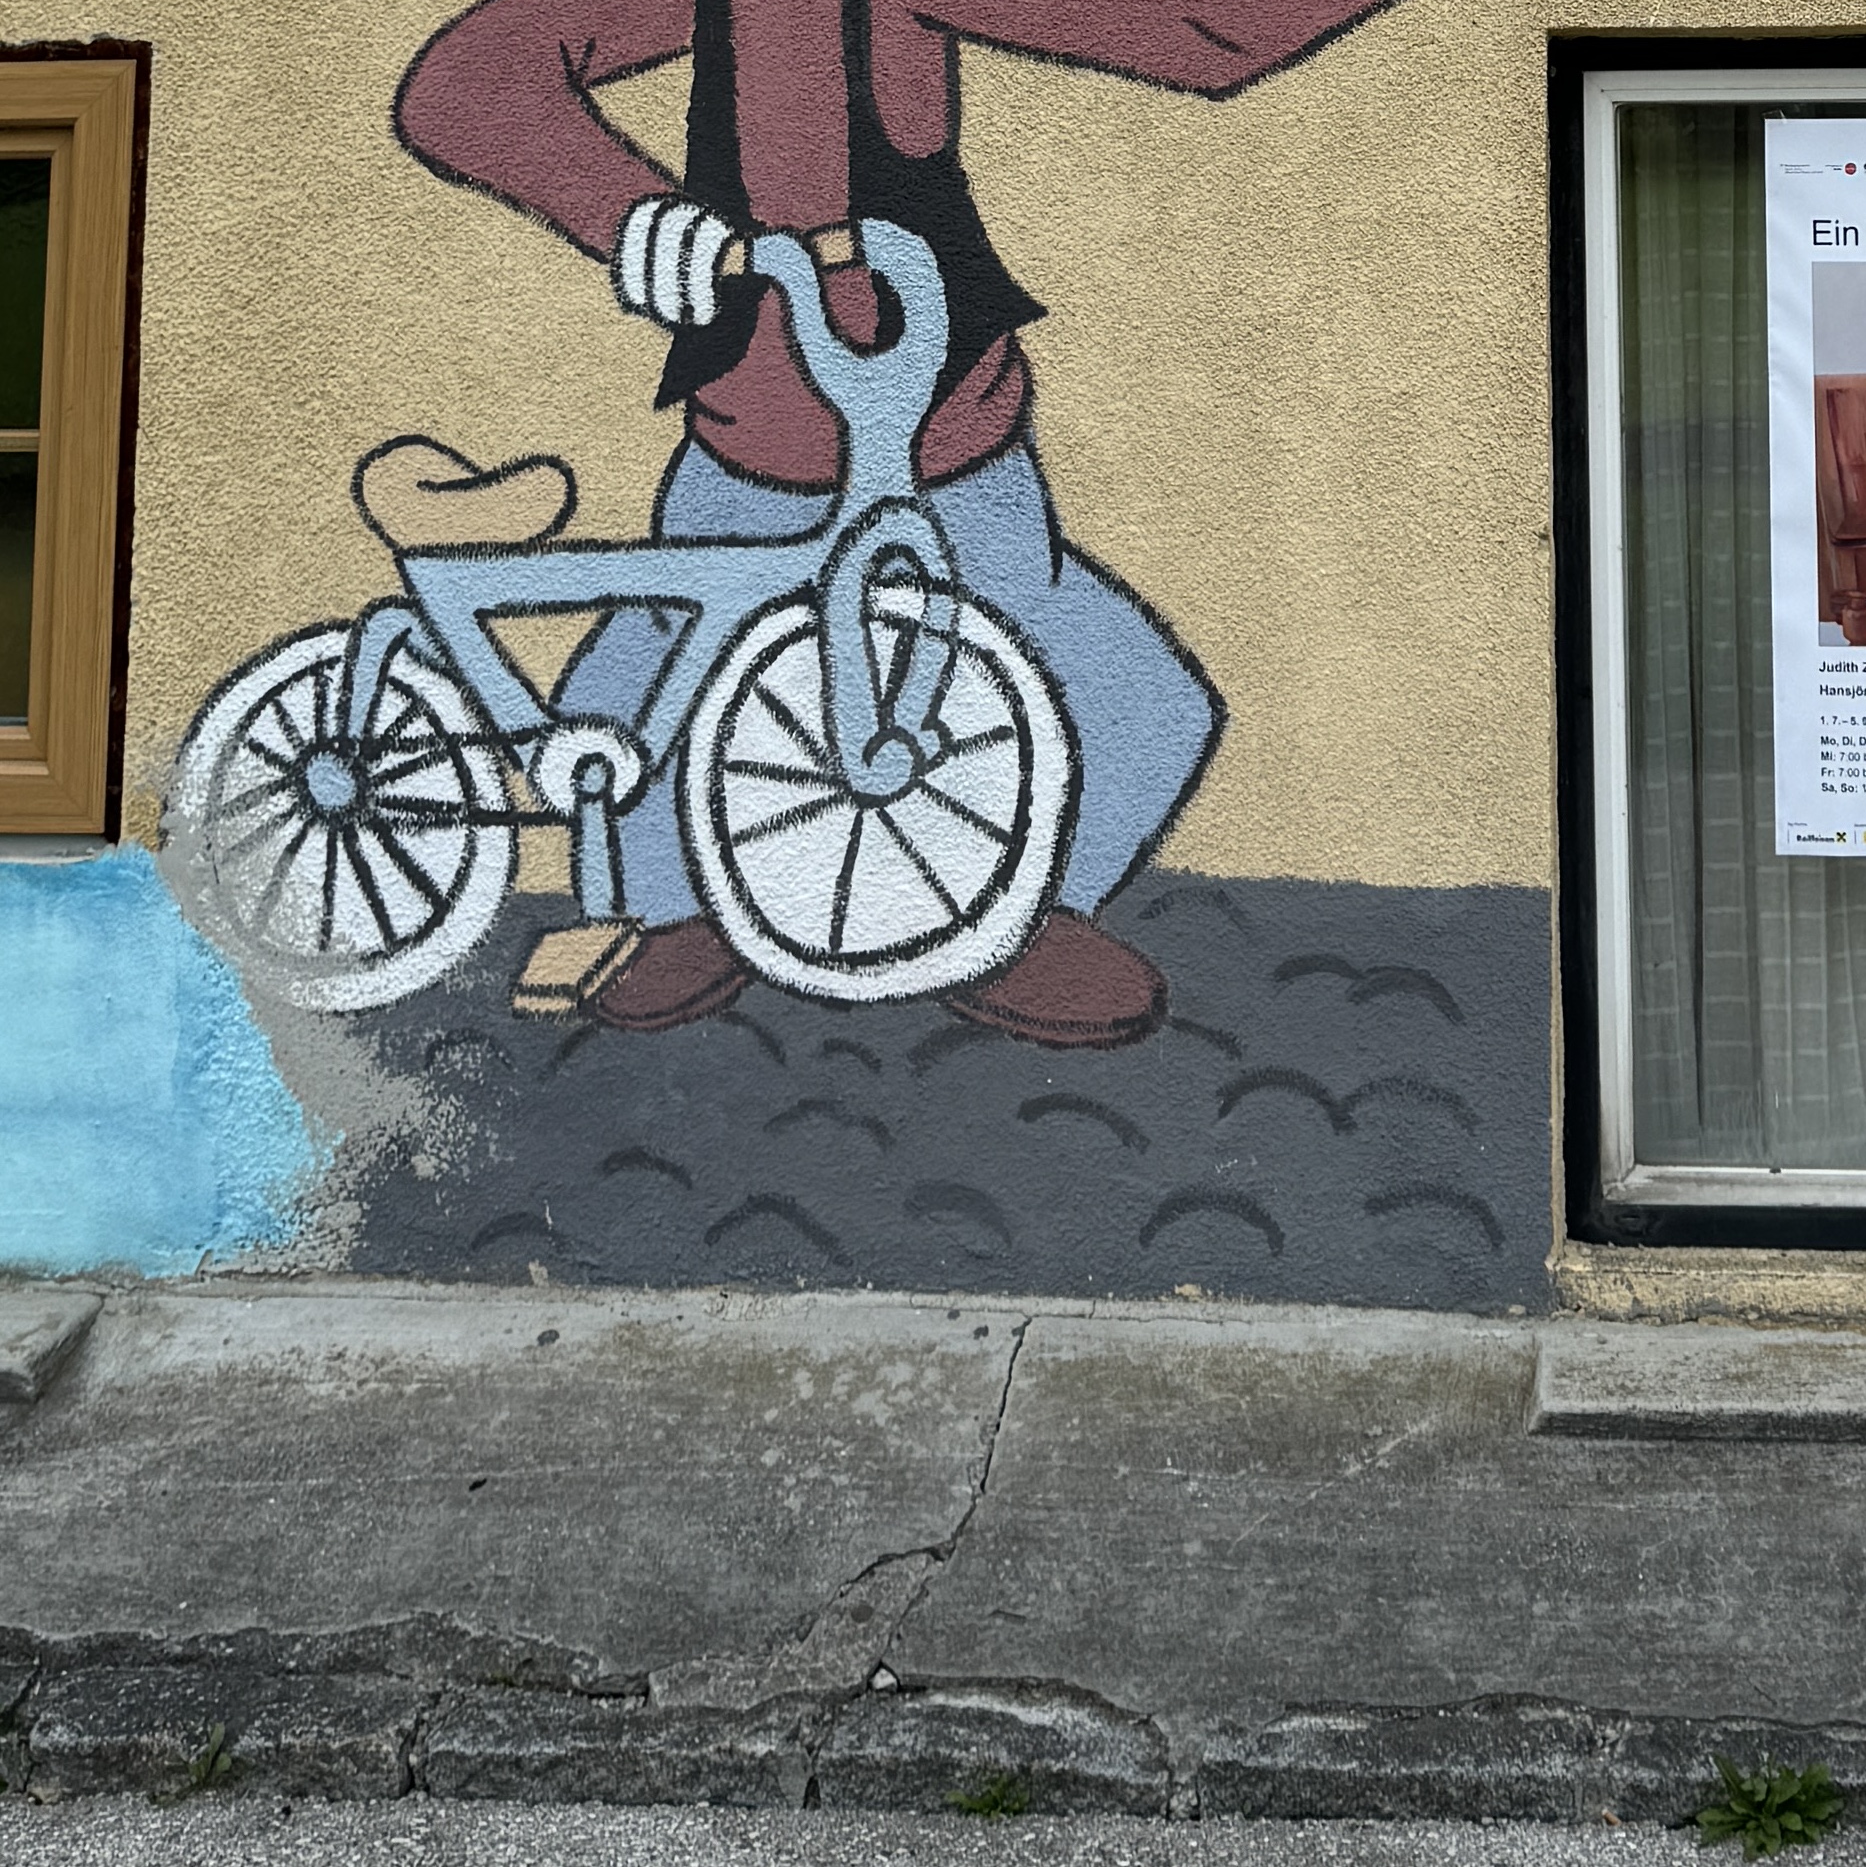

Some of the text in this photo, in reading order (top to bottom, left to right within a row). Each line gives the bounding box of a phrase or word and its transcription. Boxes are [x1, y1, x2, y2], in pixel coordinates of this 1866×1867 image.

[1812, 219, 1860, 246] Ein
[1819, 661, 1858, 673] Judith
[1820, 736, 1839, 748] Mo,
[1821, 782, 1838, 794] Sa,
[1841, 782, 1858, 794] So:
